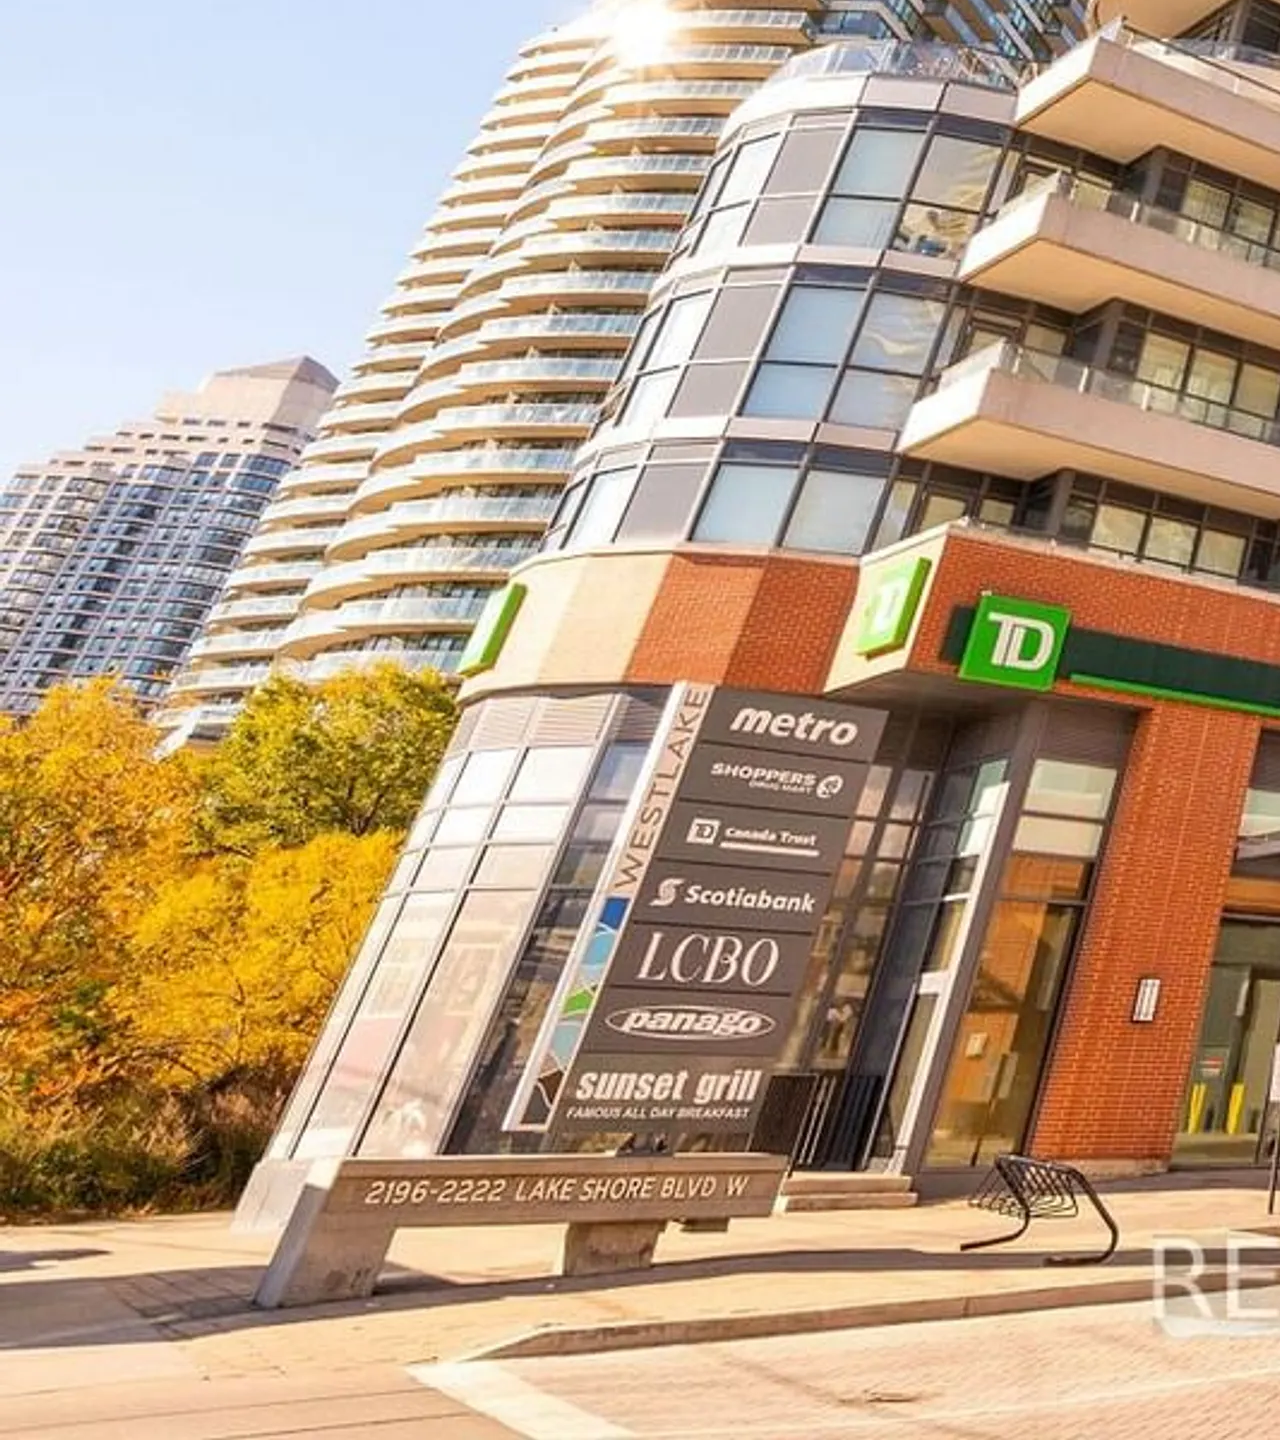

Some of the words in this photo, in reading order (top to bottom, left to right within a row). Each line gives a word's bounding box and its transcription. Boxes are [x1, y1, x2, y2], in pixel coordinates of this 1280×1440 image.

[988, 612, 1055, 672] TD
[730, 707, 859, 746] metro
[614, 687, 707, 889] WESTLAKE
[711, 762, 816, 786] SHOPPERS
[782, 783, 813, 796] MART
[724, 826, 777, 842] Canada
[779, 831, 817, 847] Trust
[685, 885, 816, 913] Scotiabank
[636, 931, 780, 987] LCBO
[622, 1010, 763, 1036] panago
[576, 1071, 690, 1101] sunset
[693, 1068, 763, 1104] grill
[566, 1107, 621, 1119] FAMOUS
[623, 1107, 647, 1119] ALL
[649, 1108, 675, 1119] DAY
[677, 1107, 751, 1120] BREAKFAST
[364, 1179, 508, 1205] 2196-2222
[514, 1178, 576, 1203] LAKE
[578, 1176, 657, 1202] SHORE
[659, 1176, 717, 1199] BLVD
[726, 1175, 750, 1197] W
